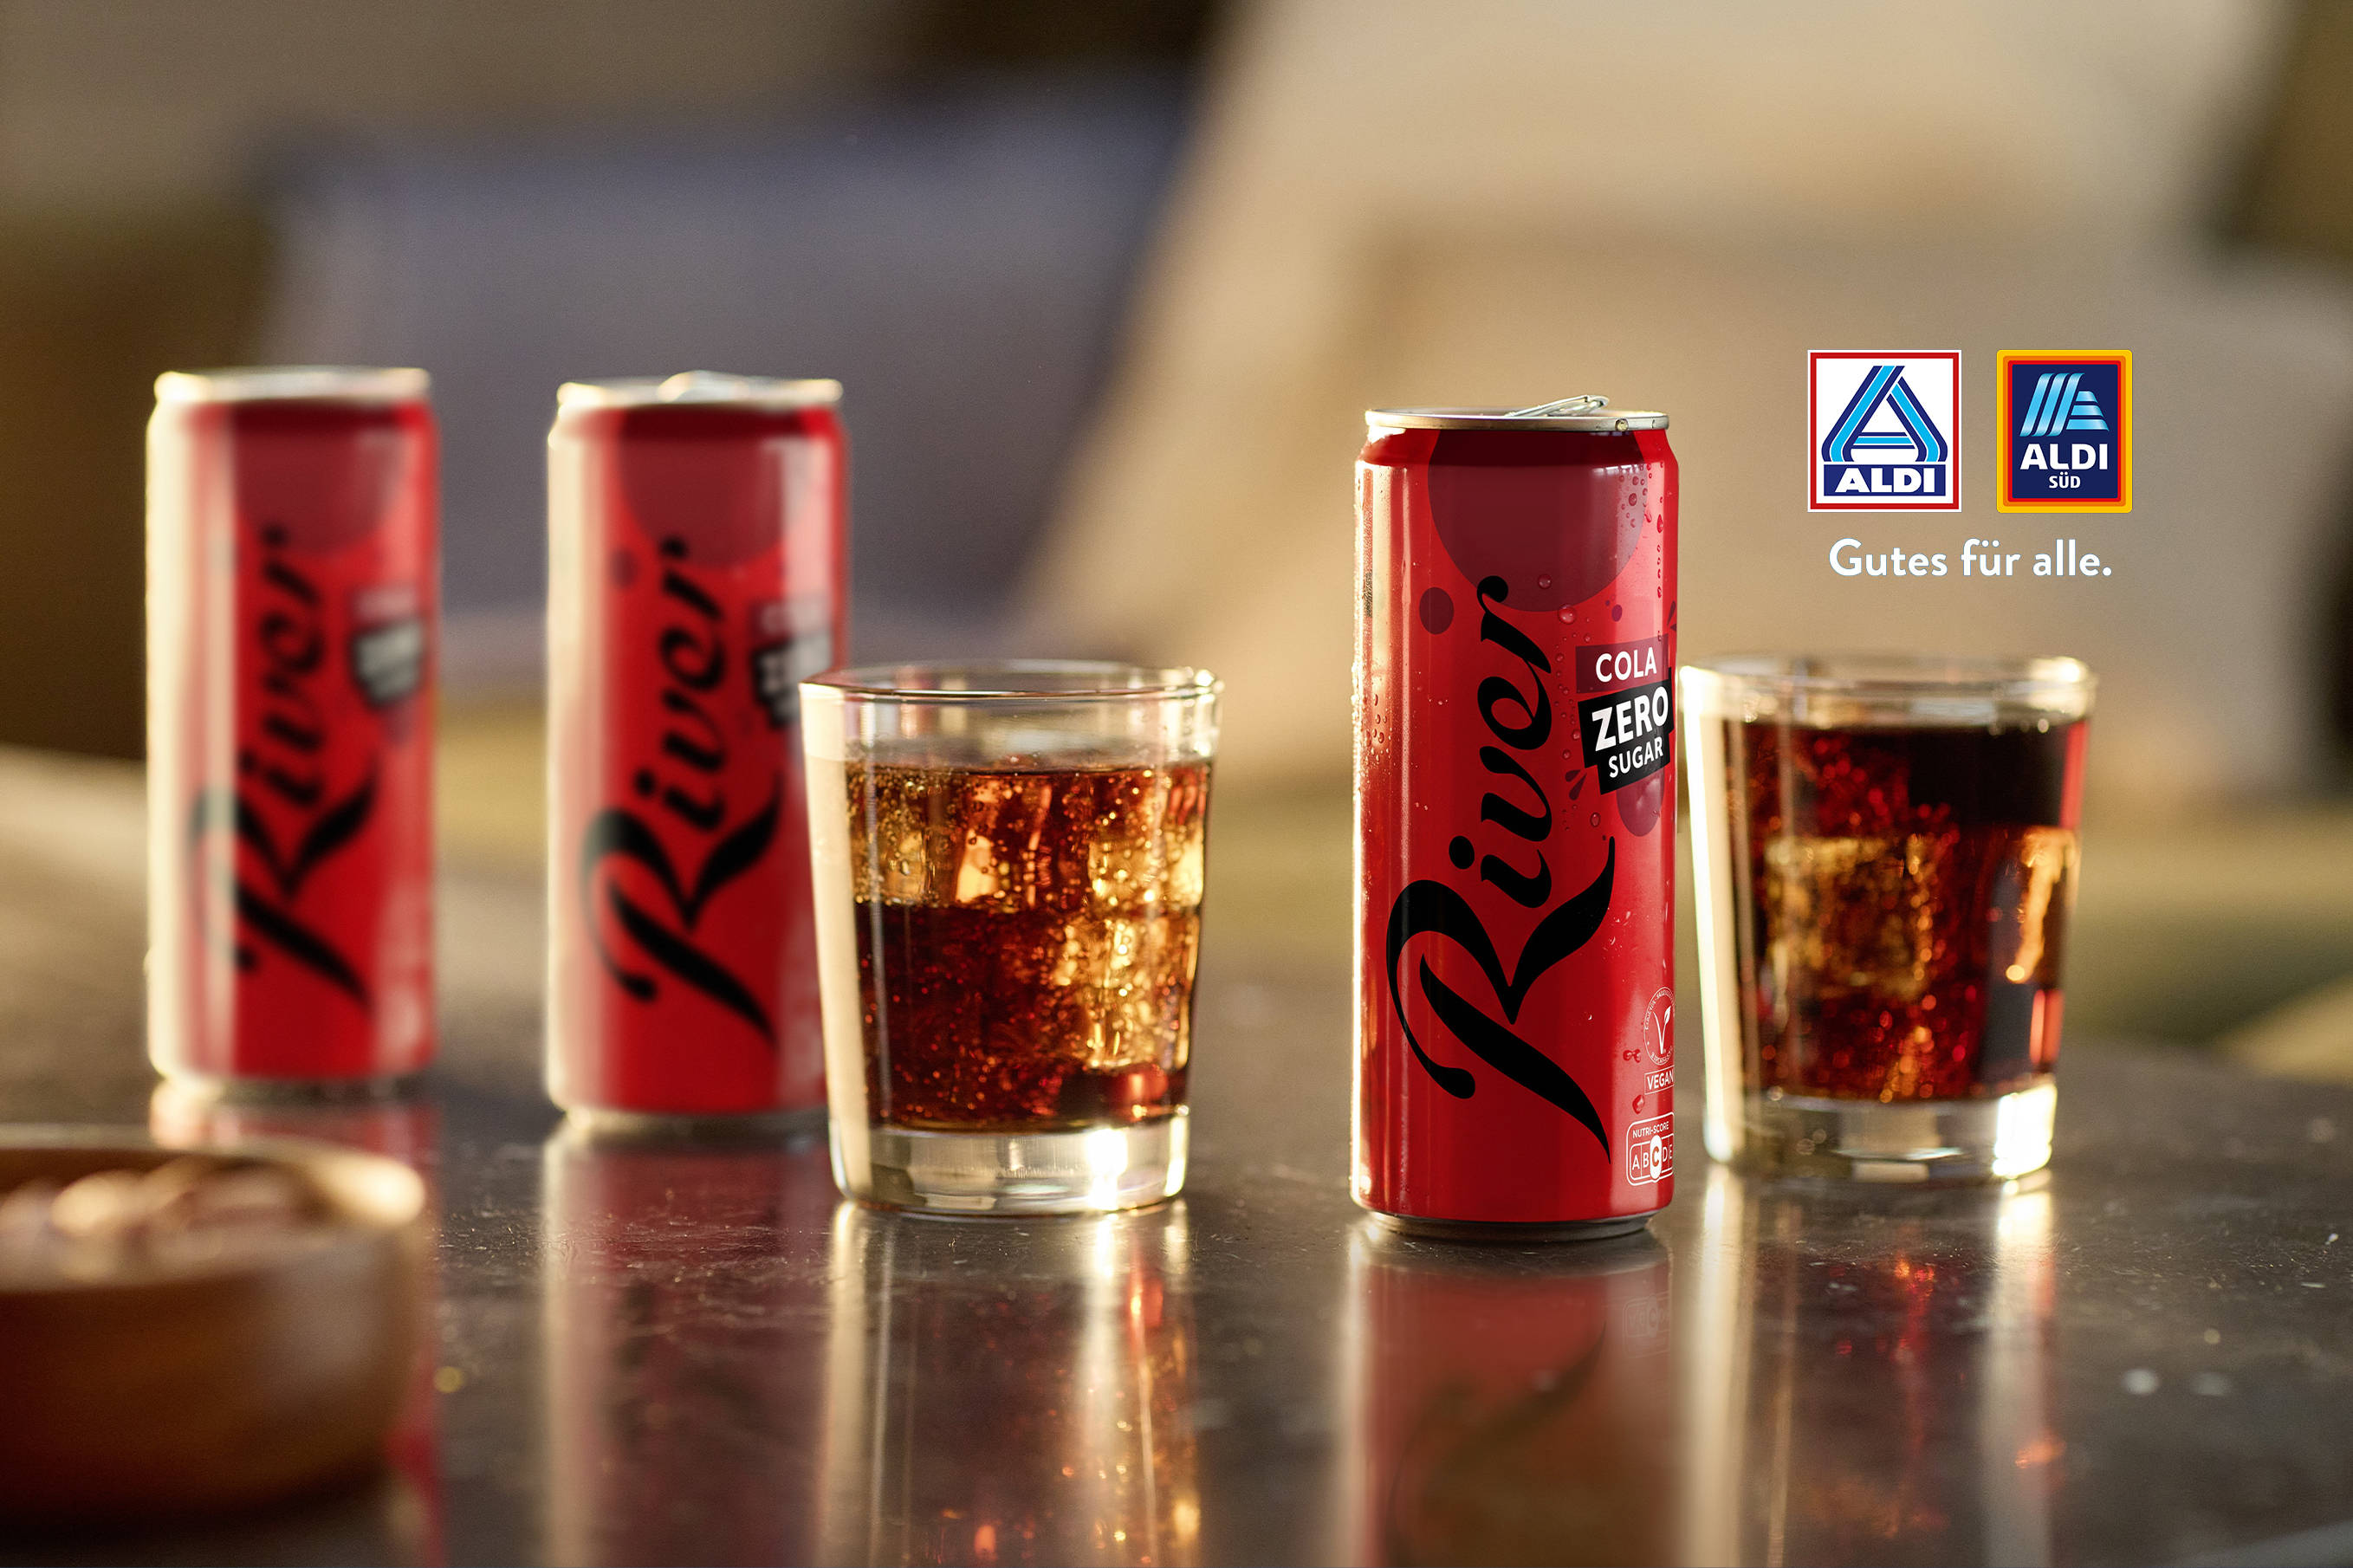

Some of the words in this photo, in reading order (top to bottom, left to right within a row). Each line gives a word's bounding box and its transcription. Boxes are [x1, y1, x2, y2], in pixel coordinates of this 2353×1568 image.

[1595, 646, 1657, 683] COLA
[1591, 686, 1669, 752] ZERO
[1608, 736, 1663, 779] SUGAR
[578, 532, 785, 1053] River
[1386, 575, 1616, 1164] River
[1647, 1069, 1674, 1091] VEGAN
[1632, 1121, 1669, 1138] NUTRI-SCORE
